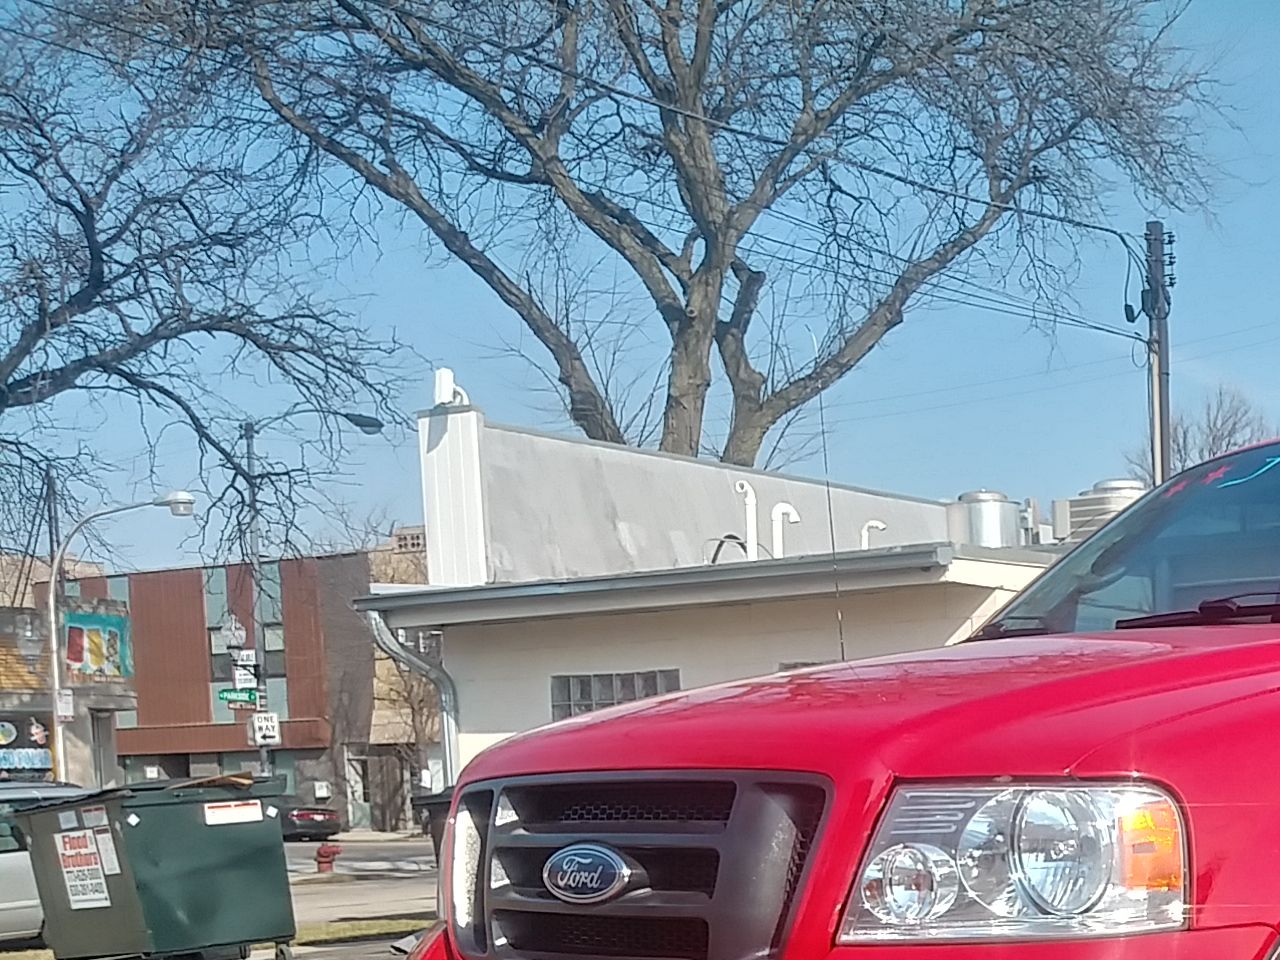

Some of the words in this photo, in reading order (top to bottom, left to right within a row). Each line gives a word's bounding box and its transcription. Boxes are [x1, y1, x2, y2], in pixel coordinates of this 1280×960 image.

[257, 715, 275, 724] ONE
[257, 725, 276, 735] WAY
[62, 832, 88, 851] Flood
[557, 856, 603, 889] Ford
